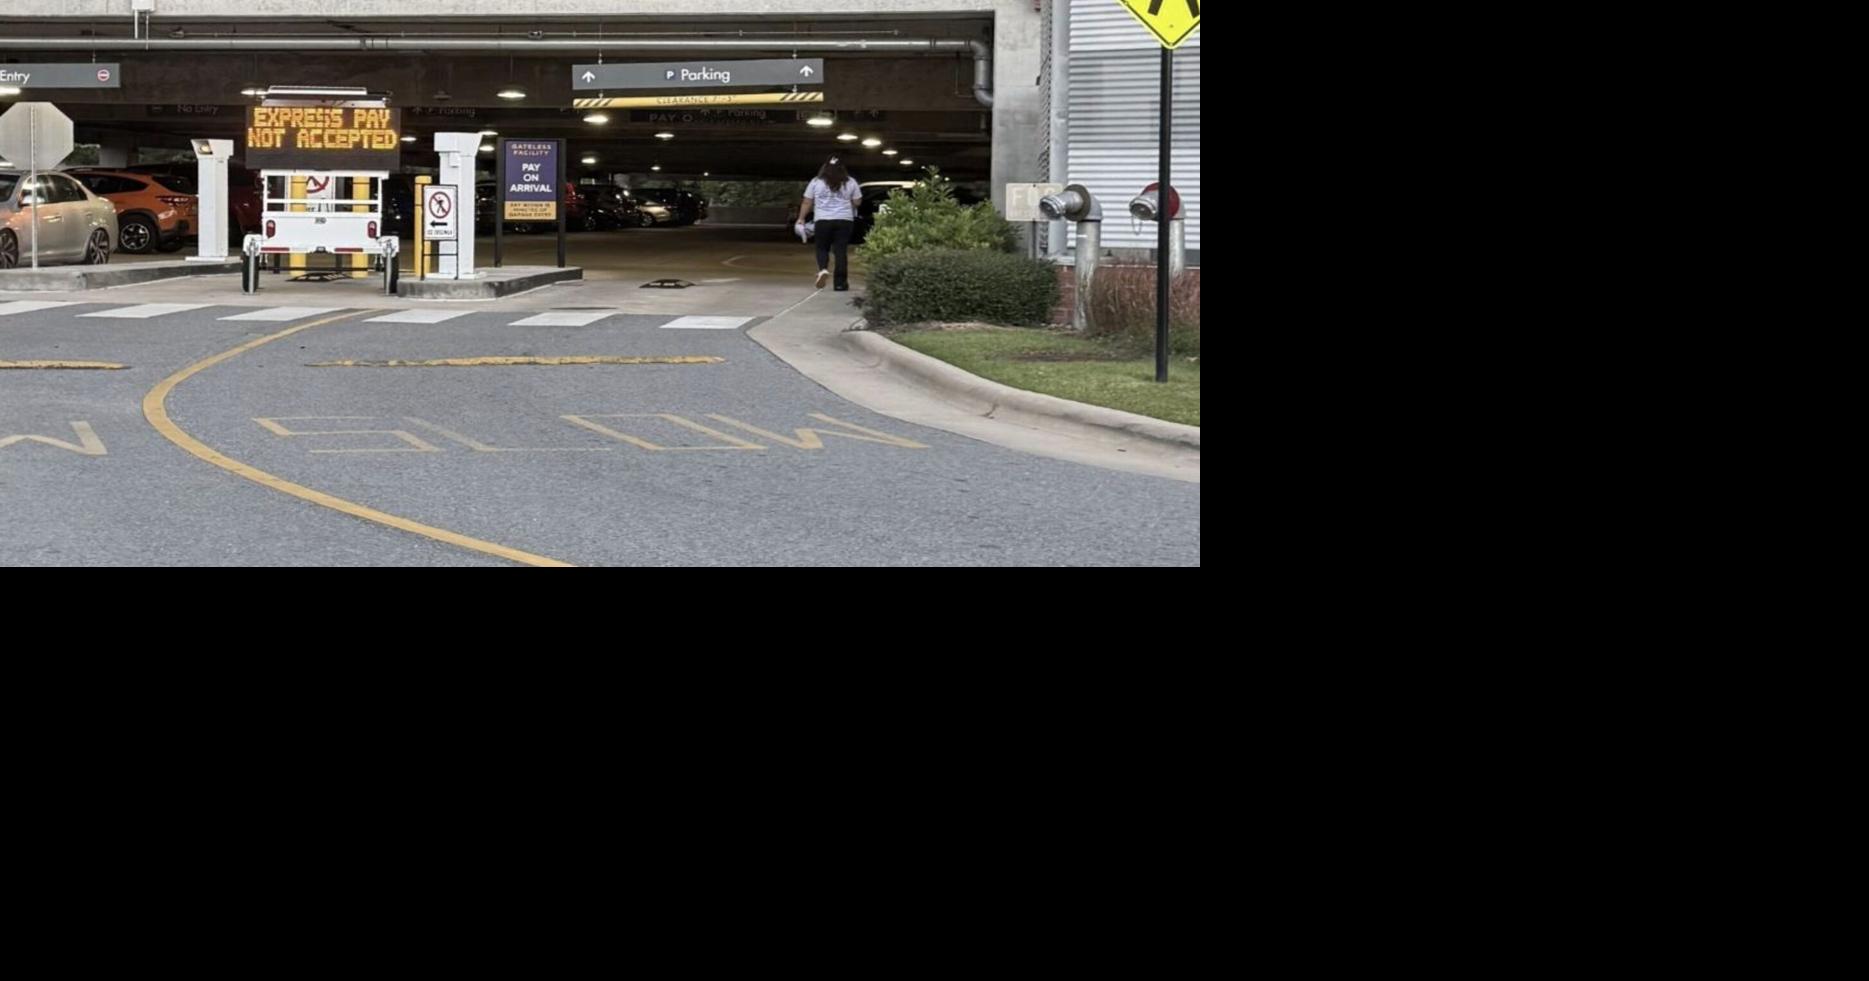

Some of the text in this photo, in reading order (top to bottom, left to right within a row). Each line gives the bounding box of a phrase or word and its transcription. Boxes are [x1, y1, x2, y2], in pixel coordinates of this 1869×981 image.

[0, 69, 30, 85] Entry
[681, 67, 731, 83] Parking
[253, 107, 391, 129] EXPRESS PAY
[247, 127, 398, 150] NOT ACCEPTED
[521, 163, 541, 171] PAY
[523, 174, 540, 182] ON
[509, 184, 553, 193] ARRIVAL
[255, 414, 930, 453] SLOW
